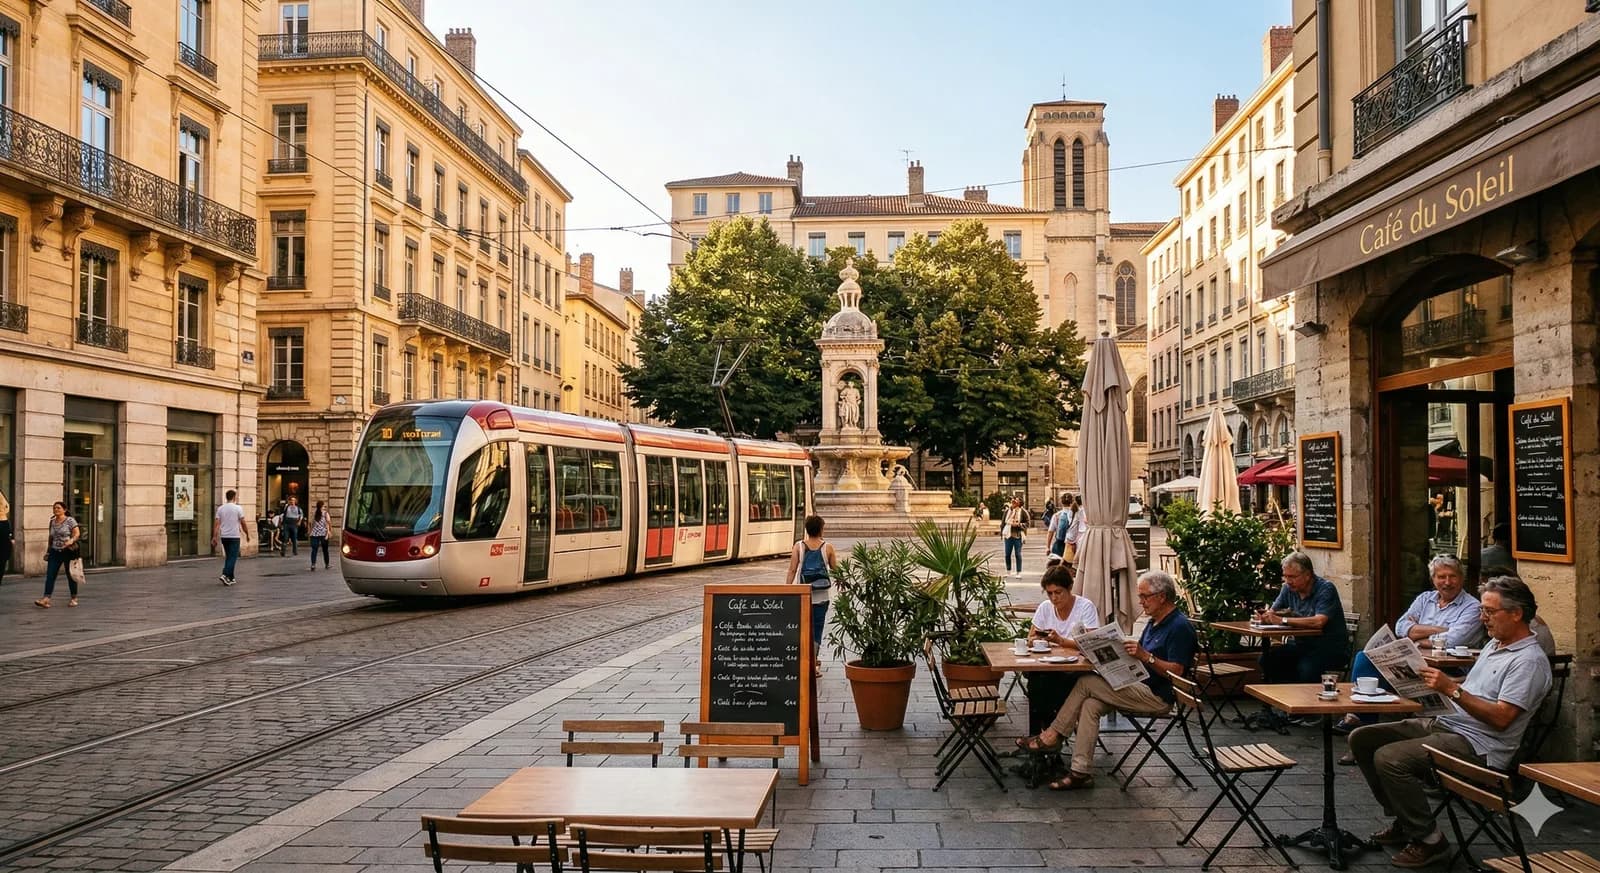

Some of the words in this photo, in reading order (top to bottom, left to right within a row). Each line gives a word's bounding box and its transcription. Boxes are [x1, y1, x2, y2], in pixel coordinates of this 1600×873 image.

[1360, 208, 1403, 255] Café
[1410, 198, 1437, 234] du
[1445, 154, 1514, 220] Soleil
[728, 598, 748, 614] Café
[750, 600, 760, 610] du
